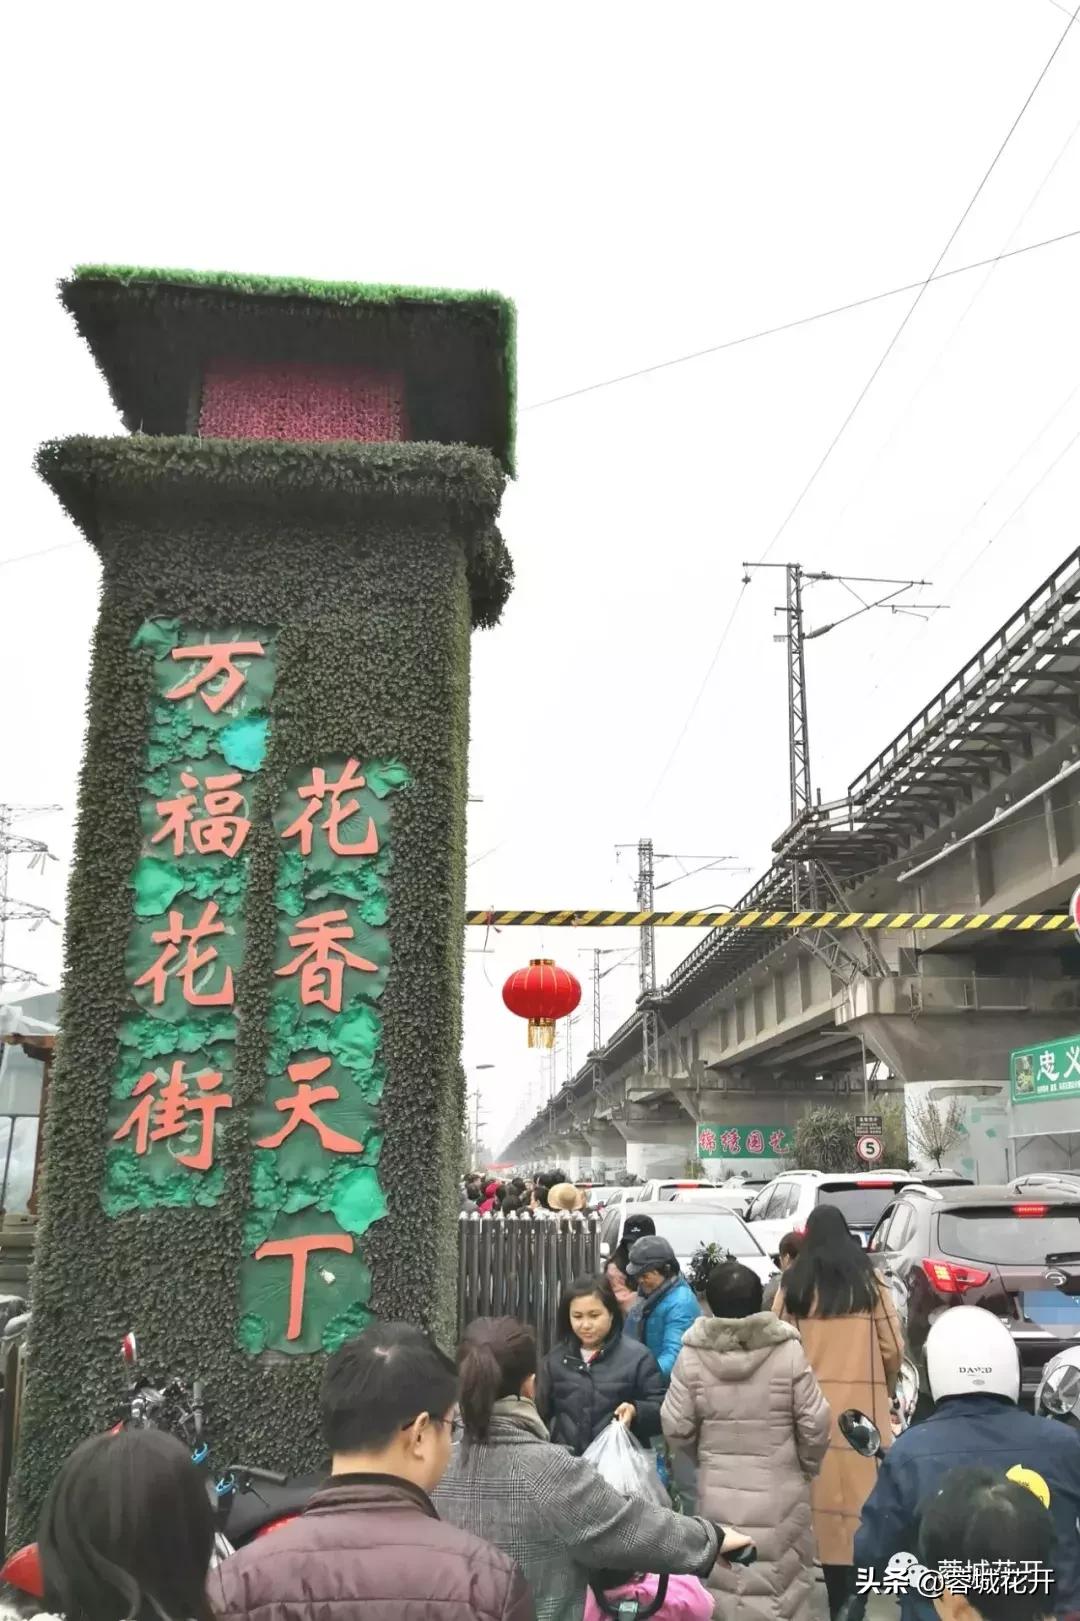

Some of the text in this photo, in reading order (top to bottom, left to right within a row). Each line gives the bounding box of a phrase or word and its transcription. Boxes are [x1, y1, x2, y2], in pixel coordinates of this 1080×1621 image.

[112, 641, 264, 1171] 万福花街
[866, 1142, 875, 1155] 5
